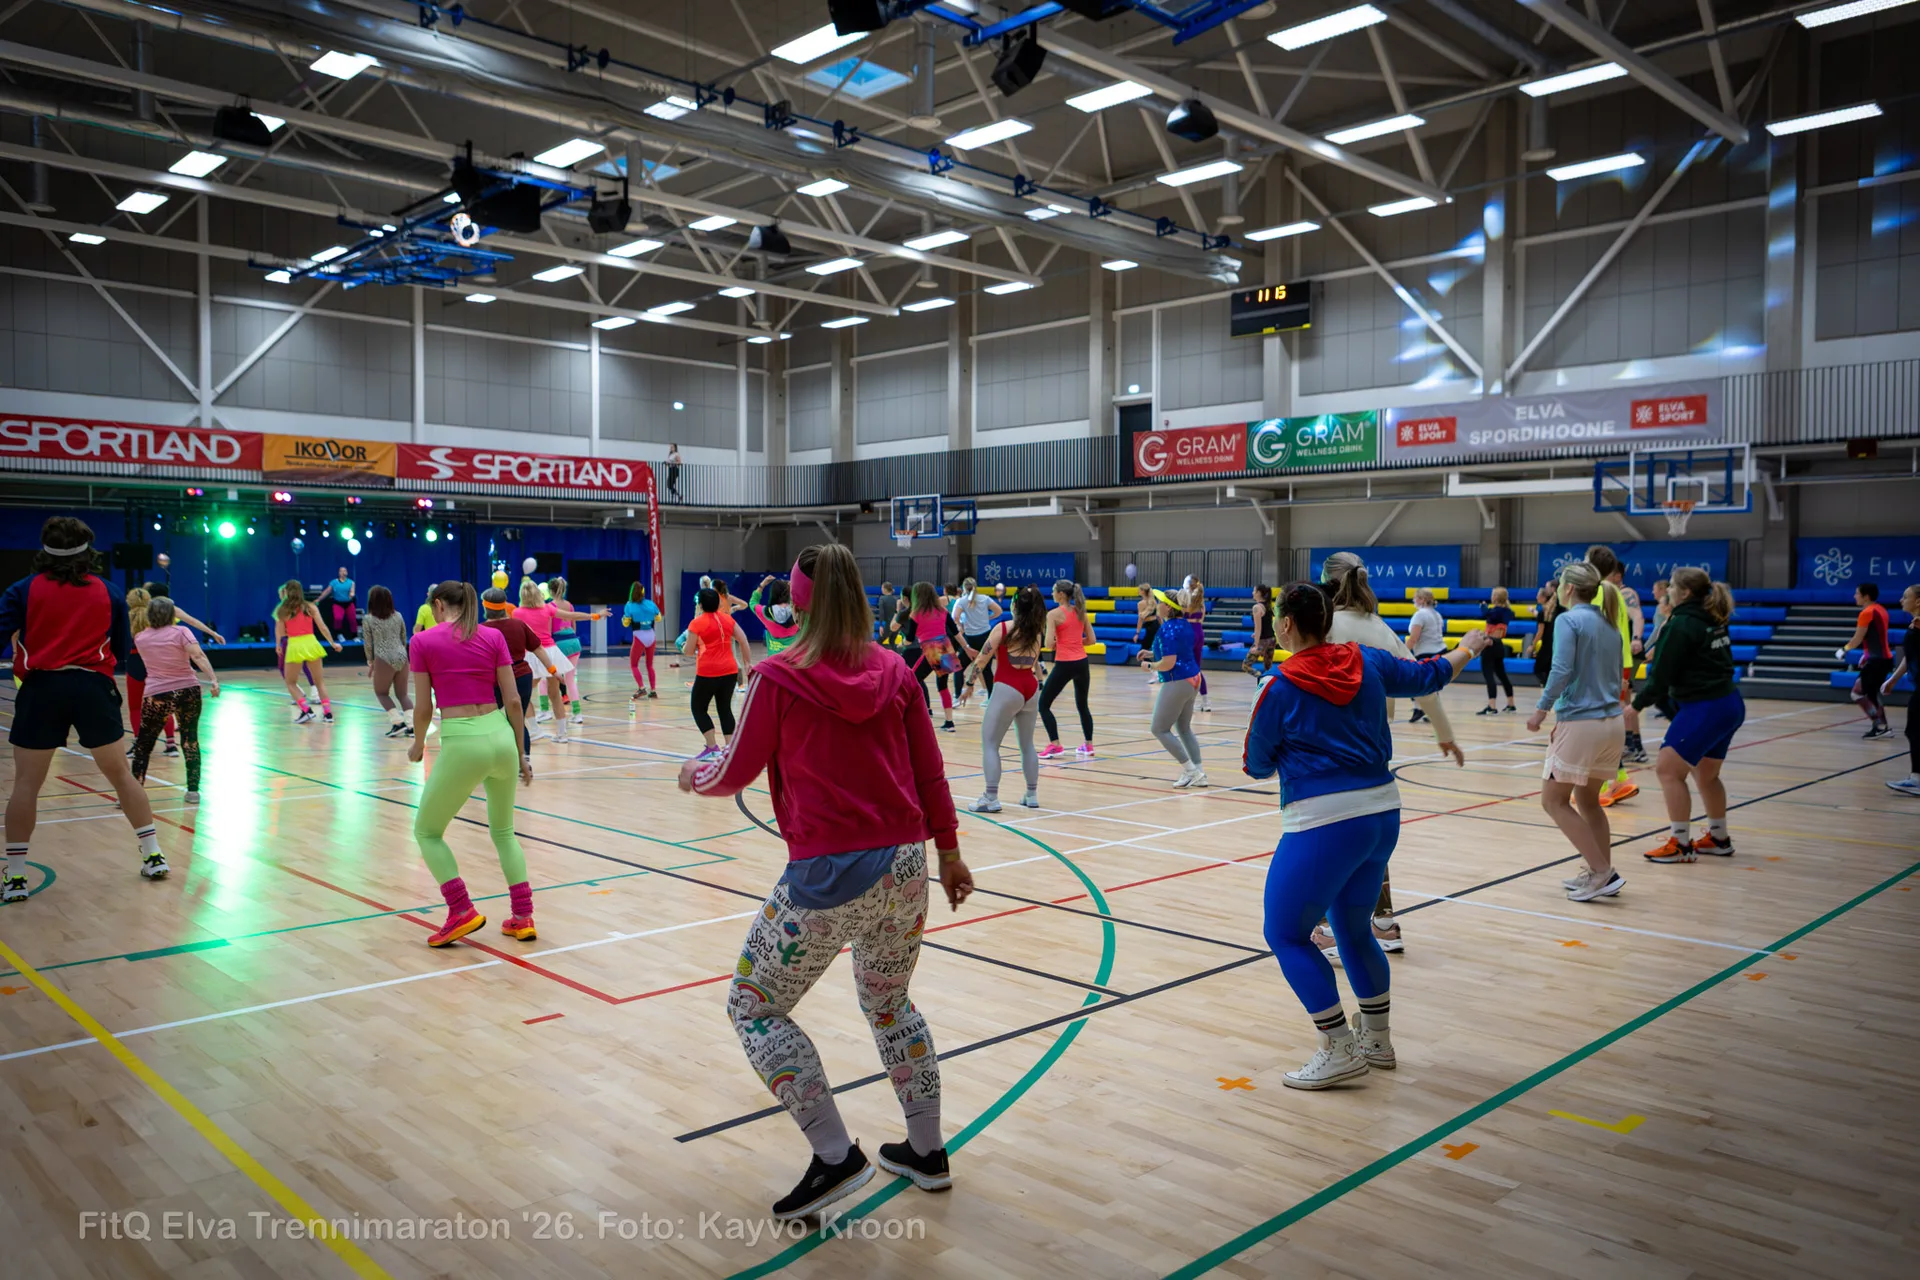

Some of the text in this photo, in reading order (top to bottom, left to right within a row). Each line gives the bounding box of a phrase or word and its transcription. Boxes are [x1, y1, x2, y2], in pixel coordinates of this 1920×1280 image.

[1515, 404, 1565, 421] ELVA
[1658, 401, 1685, 413] ELVA
[1658, 410, 1696, 424] SPORT
[1418, 422, 1440, 433] ELVA
[1418, 430, 1447, 442] SPORT
[1469, 420, 1616, 446] SPORDIHOONE
[0, 420, 241, 464] SPORTLAND
[295, 440, 367, 461] IKODOR
[1296, 444, 1364, 458] WELLNESS DRINK
[1176, 454, 1235, 466] WELLNESS DRINK
[472, 453, 633, 488] SPORTLAND
[1006, 566, 1066, 579] ELVA VALD
[1367, 564, 1447, 578] LVA VALD
[1656, 562, 1711, 577] VAD
[1869, 556, 1916, 576] ELV
[895, 847, 921, 871] DRAMA
[773, 889, 798, 911] EKEND
[751, 928, 774, 953] STAY
[863, 958, 913, 974] QUEEN
[875, 956, 910, 967] DRAMA
[759, 963, 806, 985] unicorns
[885, 1018, 927, 1044] WEEKEN
[755, 1030, 802, 1065] unicorns
